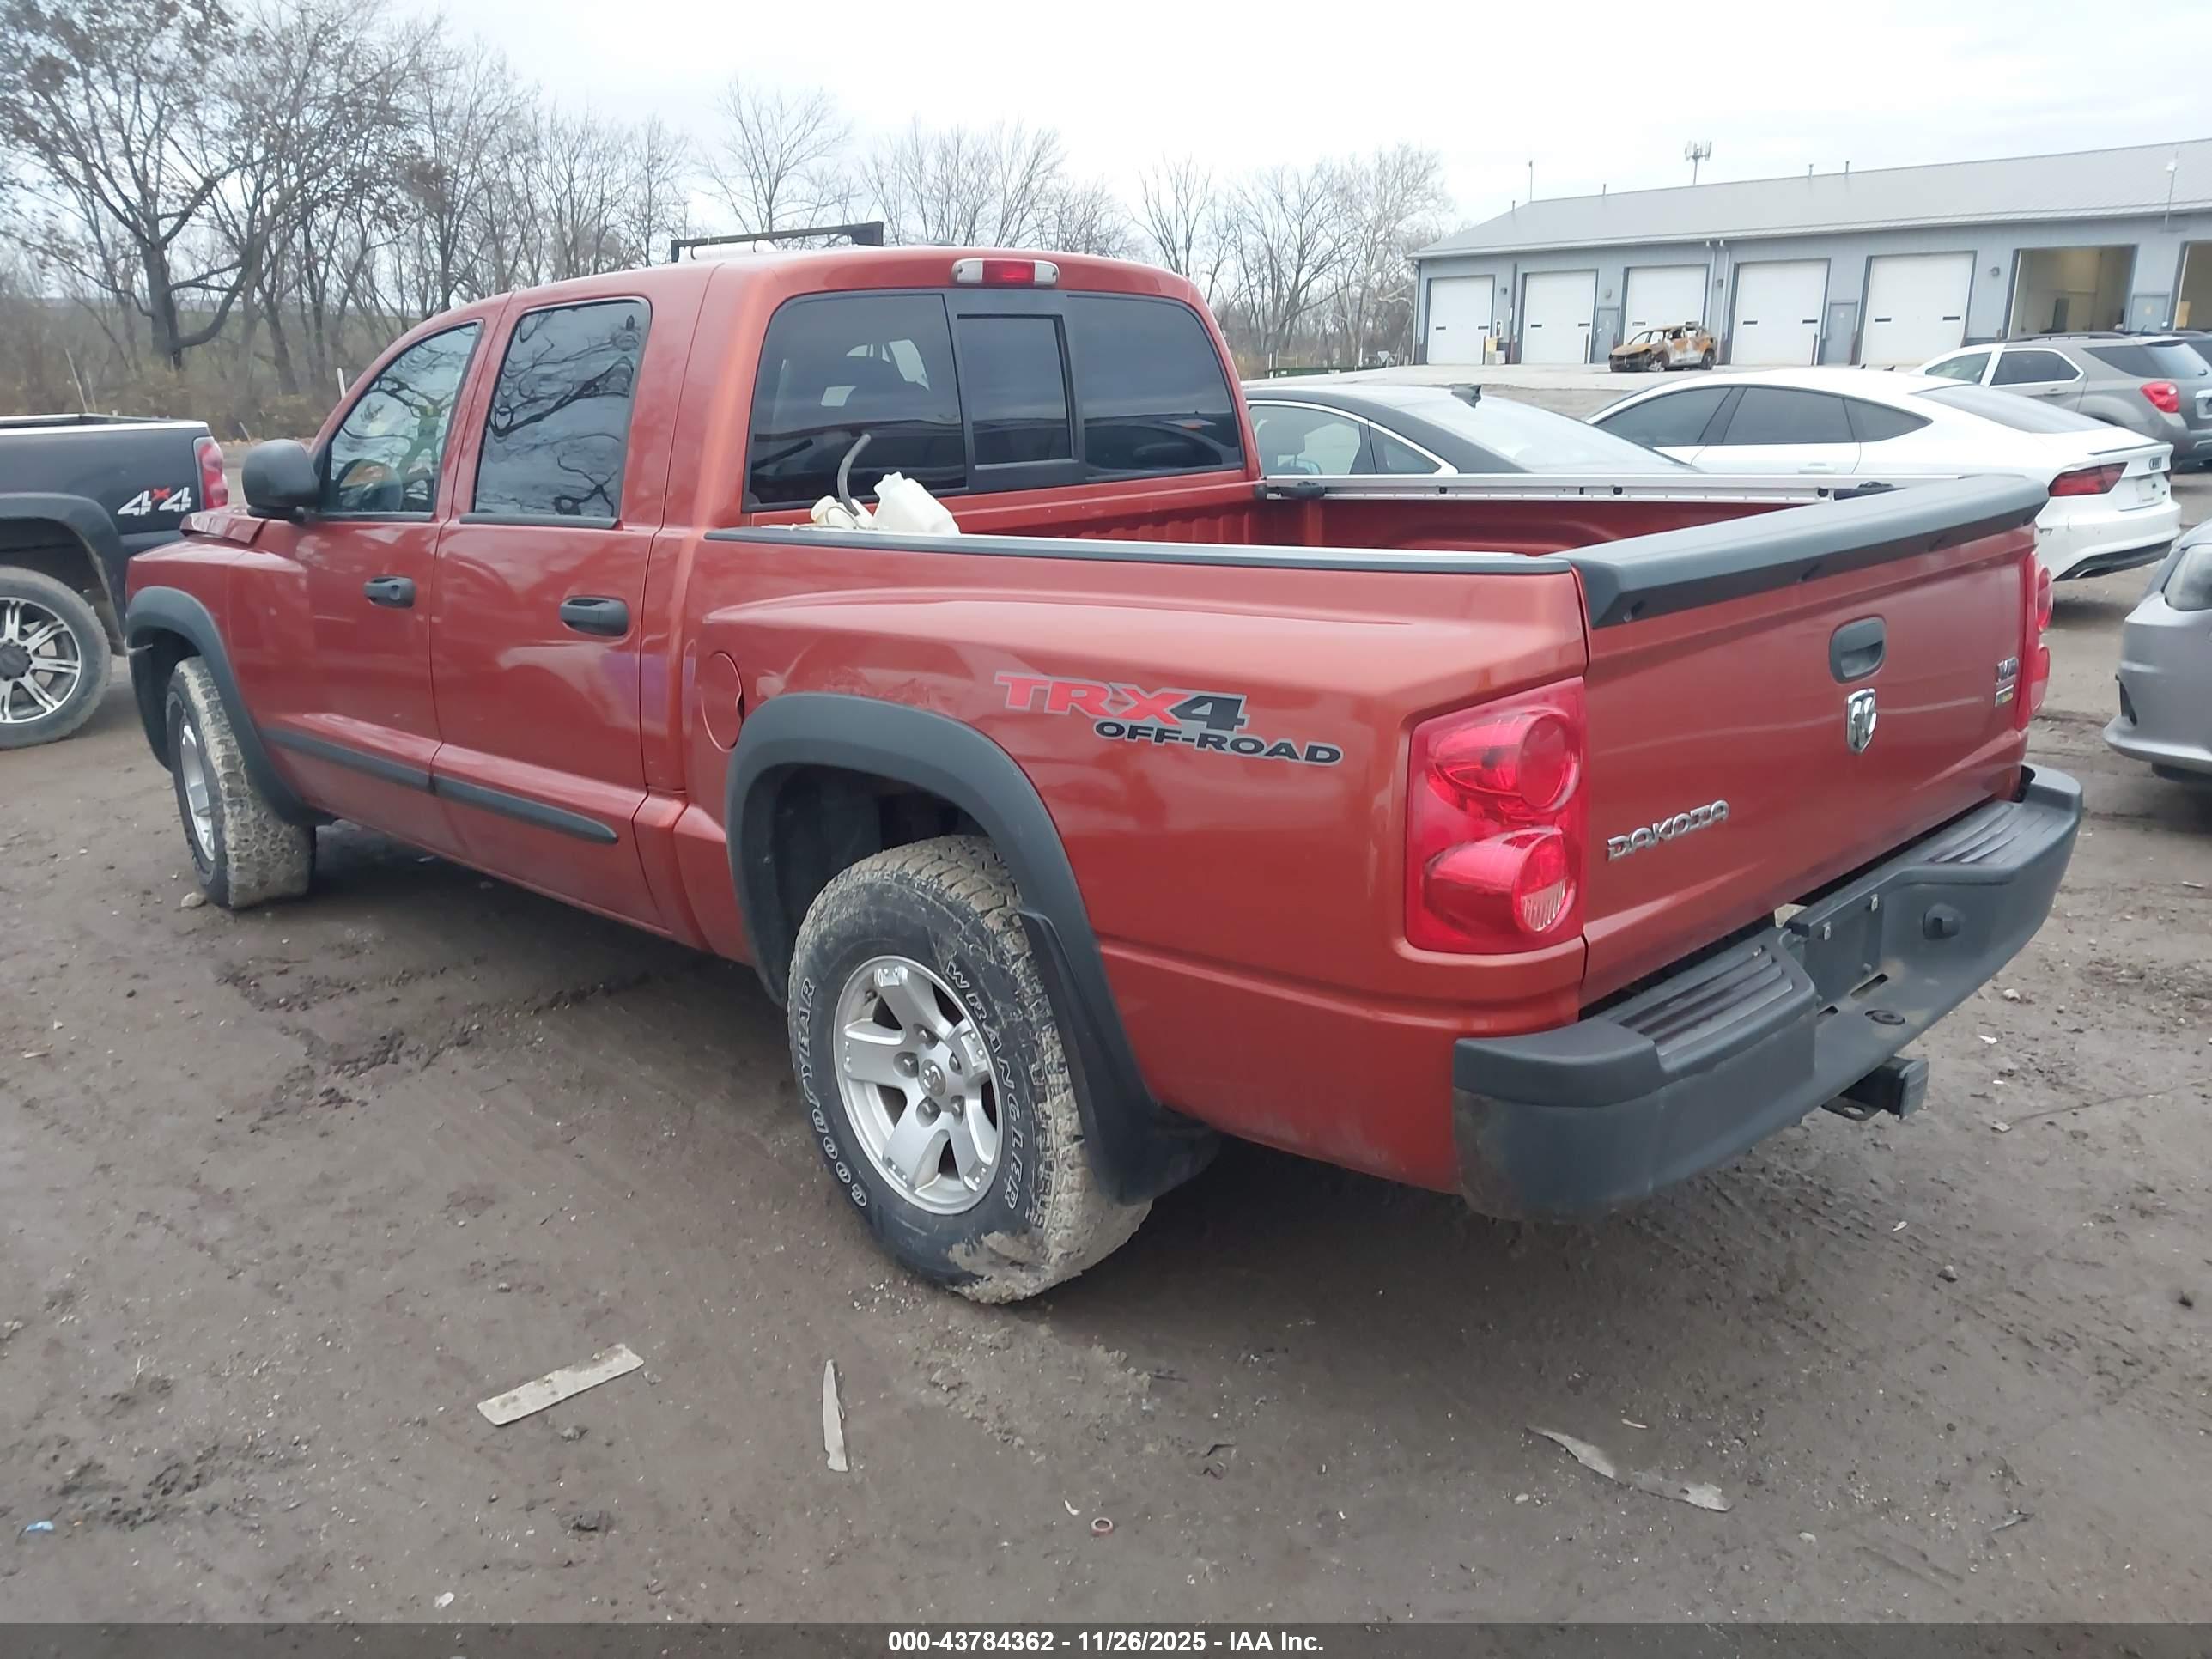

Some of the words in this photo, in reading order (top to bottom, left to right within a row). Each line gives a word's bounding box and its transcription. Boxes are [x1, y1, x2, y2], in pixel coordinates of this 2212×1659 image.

[994, 672, 1249, 732] TRX4
[1093, 720, 1343, 764] OFF-ROAD
[1607, 799, 1729, 862] DAKOTA
[799, 976, 867, 1208] GOODYEAR
[947, 957, 1024, 1210] WRANGLER
